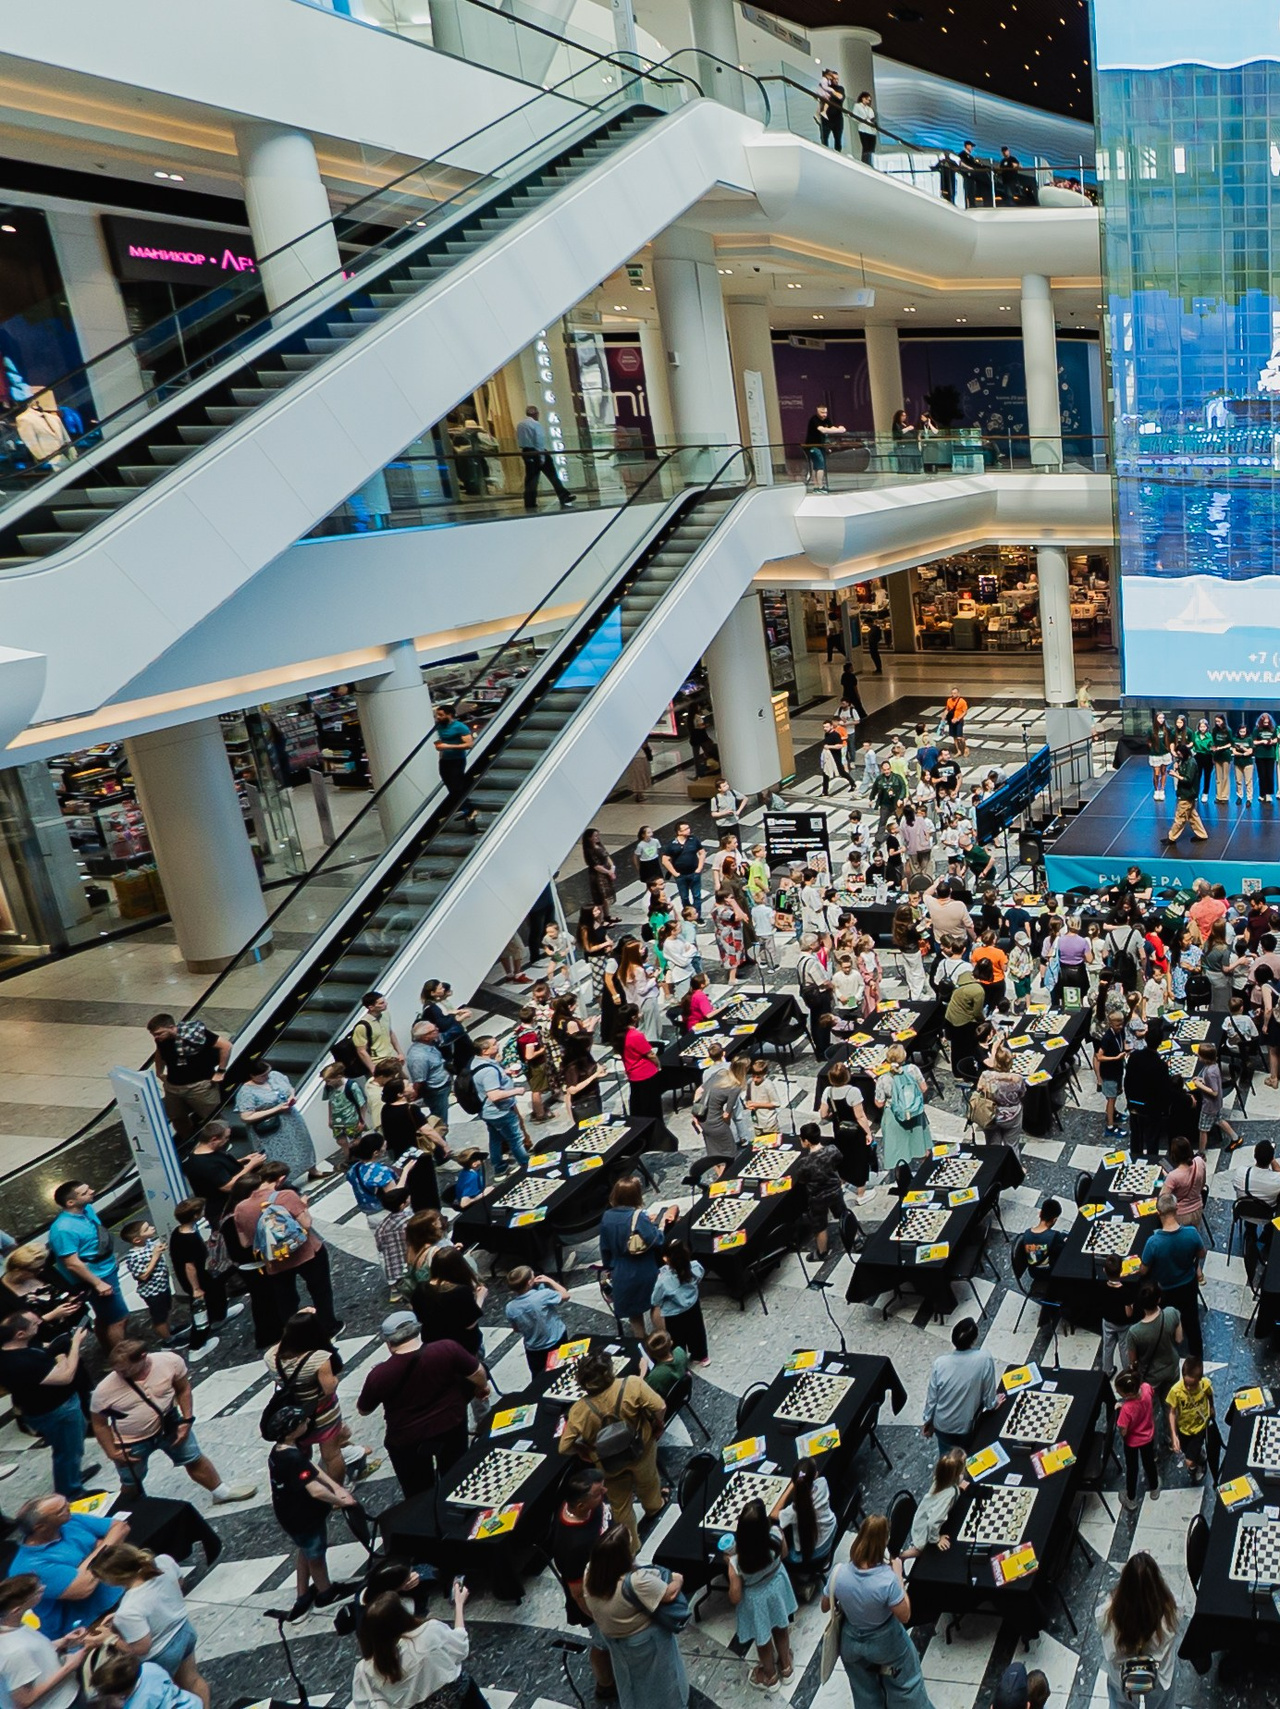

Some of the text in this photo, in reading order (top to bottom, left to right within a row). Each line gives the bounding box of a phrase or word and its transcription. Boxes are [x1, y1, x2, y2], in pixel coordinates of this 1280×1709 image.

[129, 245, 206, 265] МАНИКЮР
[1248, 652, 1267, 664] +7
[1099, 874, 1183, 887] РИЕРА
[1066, 989, 1078, 1004] B
[133, 1093, 140, 1102] 3
[140, 1115, 146, 1123] 2
[132, 1136, 145, 1153] 1
